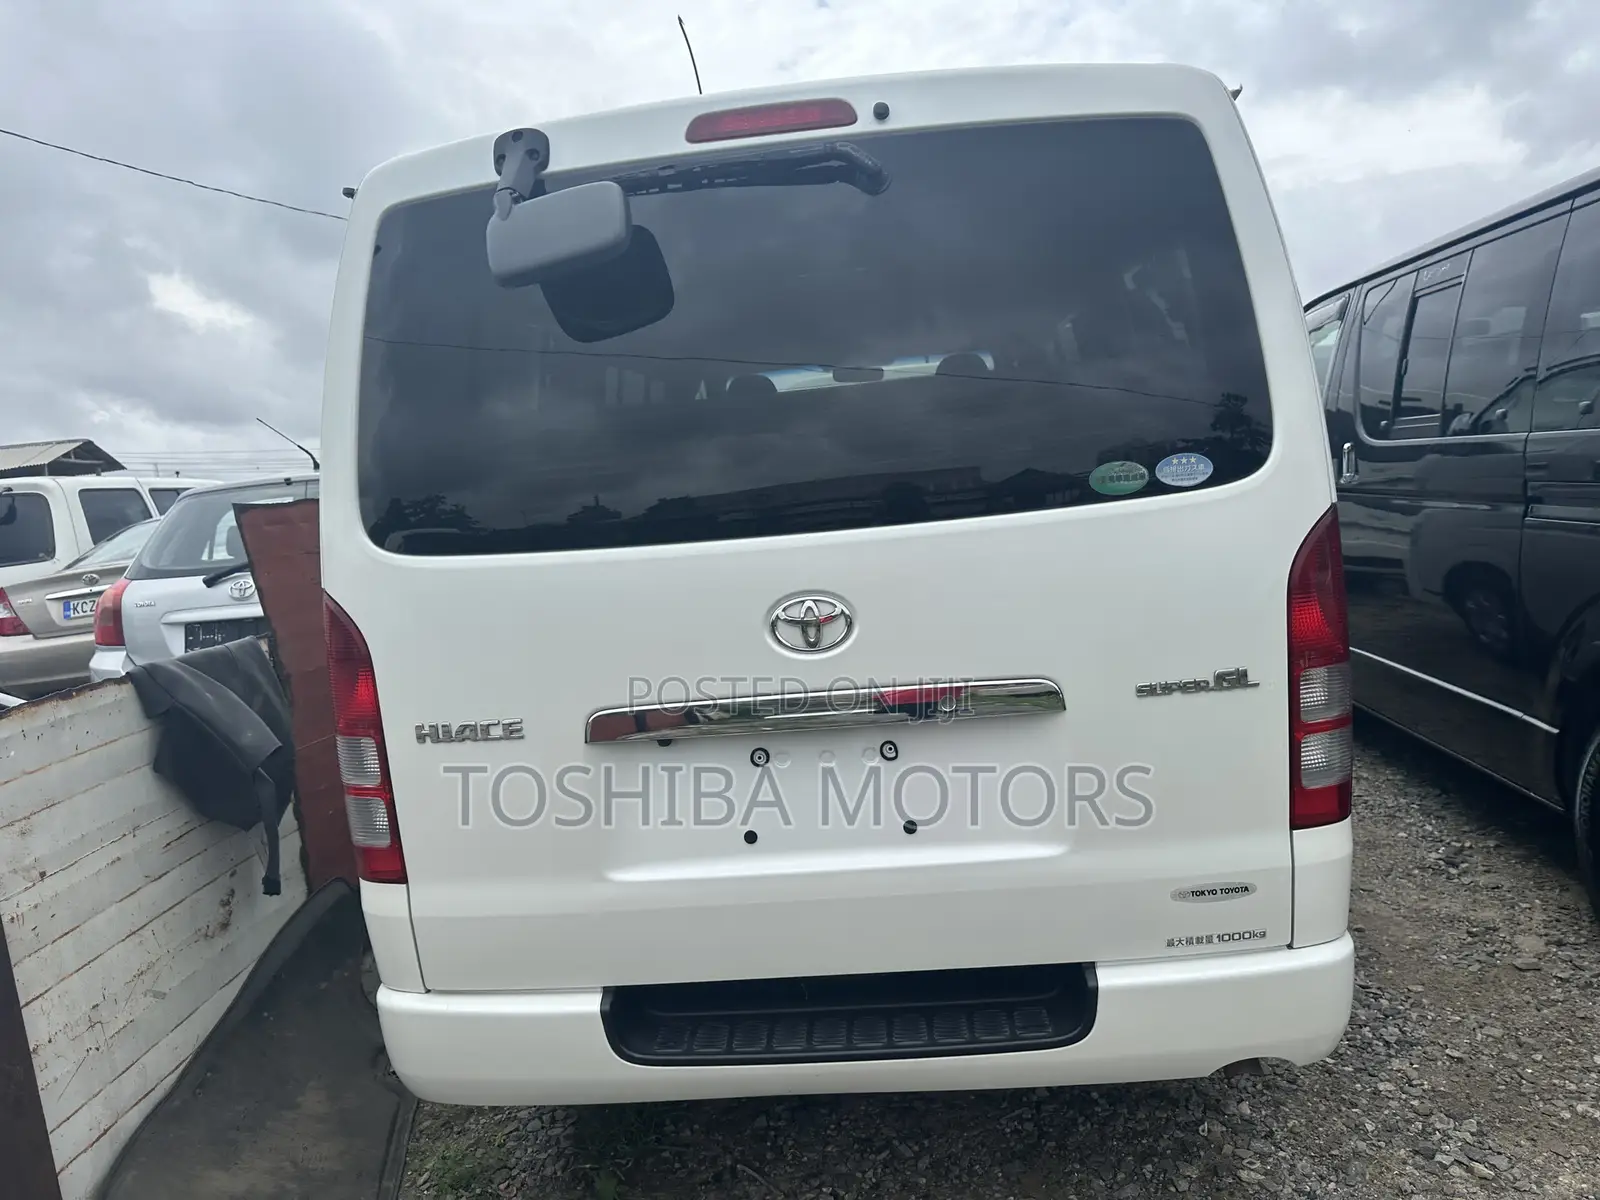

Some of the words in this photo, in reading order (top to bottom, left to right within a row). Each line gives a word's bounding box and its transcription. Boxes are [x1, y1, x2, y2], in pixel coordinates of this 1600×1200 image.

[1135, 678, 1210, 697] SUPER
[1213, 666, 1260, 688] GL
[415, 718, 525, 744] HIACE
[1191, 888, 1217, 898] TOKYO
[1219, 885, 1249, 896] TOYOTA
